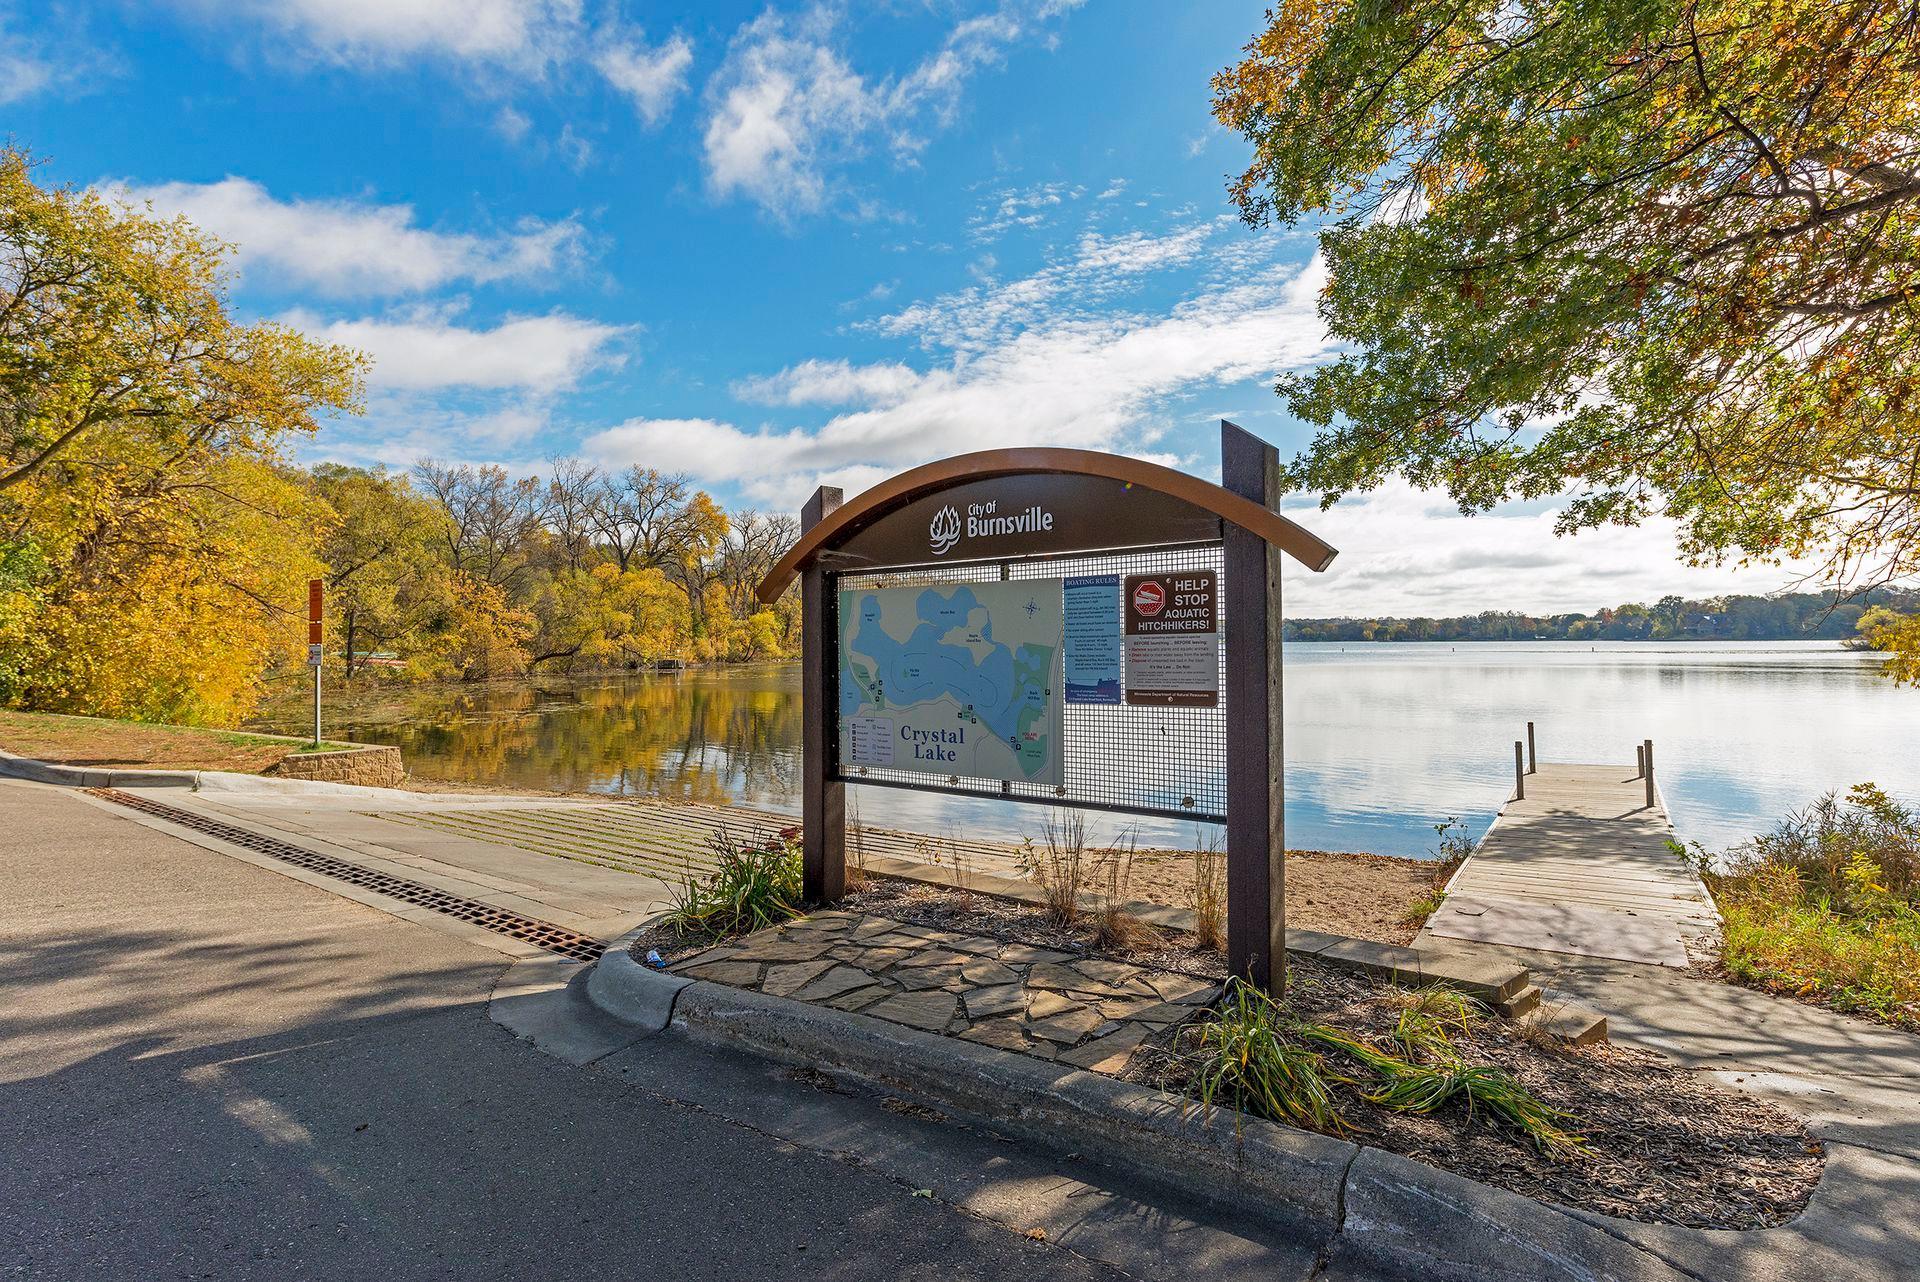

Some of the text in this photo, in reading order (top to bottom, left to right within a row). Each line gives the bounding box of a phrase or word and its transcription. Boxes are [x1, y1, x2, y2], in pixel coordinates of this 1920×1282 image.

[968, 500, 997, 518] City Of
[967, 506, 1053, 538] Burnsville
[1066, 578, 1095, 586] BOATING
[1175, 579, 1209, 591] HELP
[1174, 594, 1209, 606] STOP
[1165, 608, 1210, 619] AQUATIC
[1138, 620, 1209, 631] HITCHHIKERS!
[900, 726, 965, 745] Crystal
[914, 744, 956, 761] Lake
